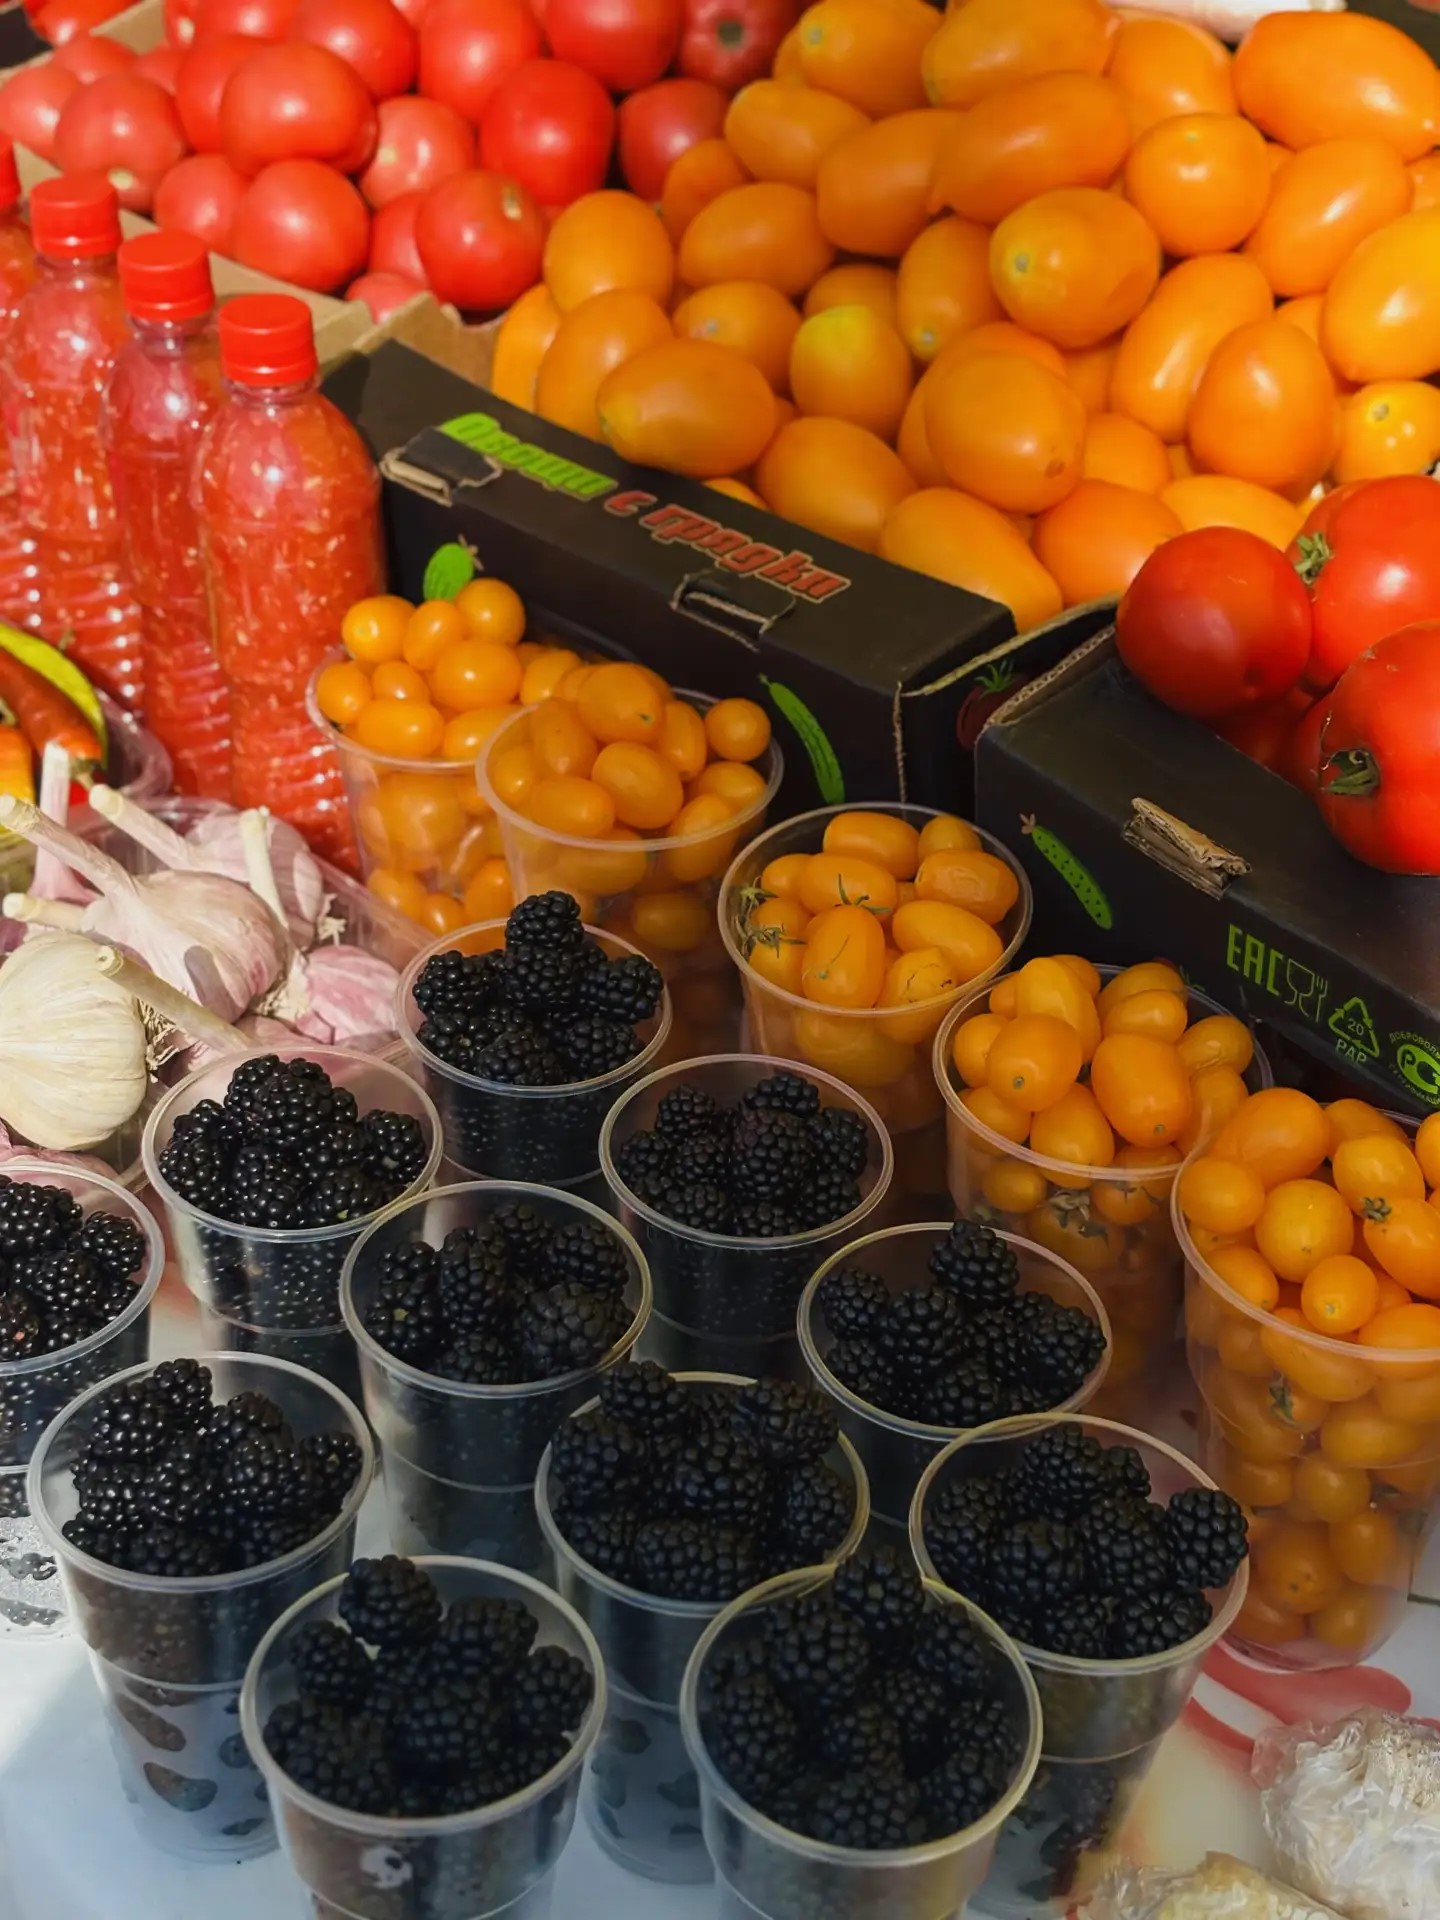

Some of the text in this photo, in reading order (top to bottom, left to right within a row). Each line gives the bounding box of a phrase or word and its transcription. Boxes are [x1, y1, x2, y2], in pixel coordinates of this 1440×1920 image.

[1226, 923, 1284, 997] EAC
[1347, 1017, 1364, 1036] 20
[1335, 1038, 1367, 1064] PAP
